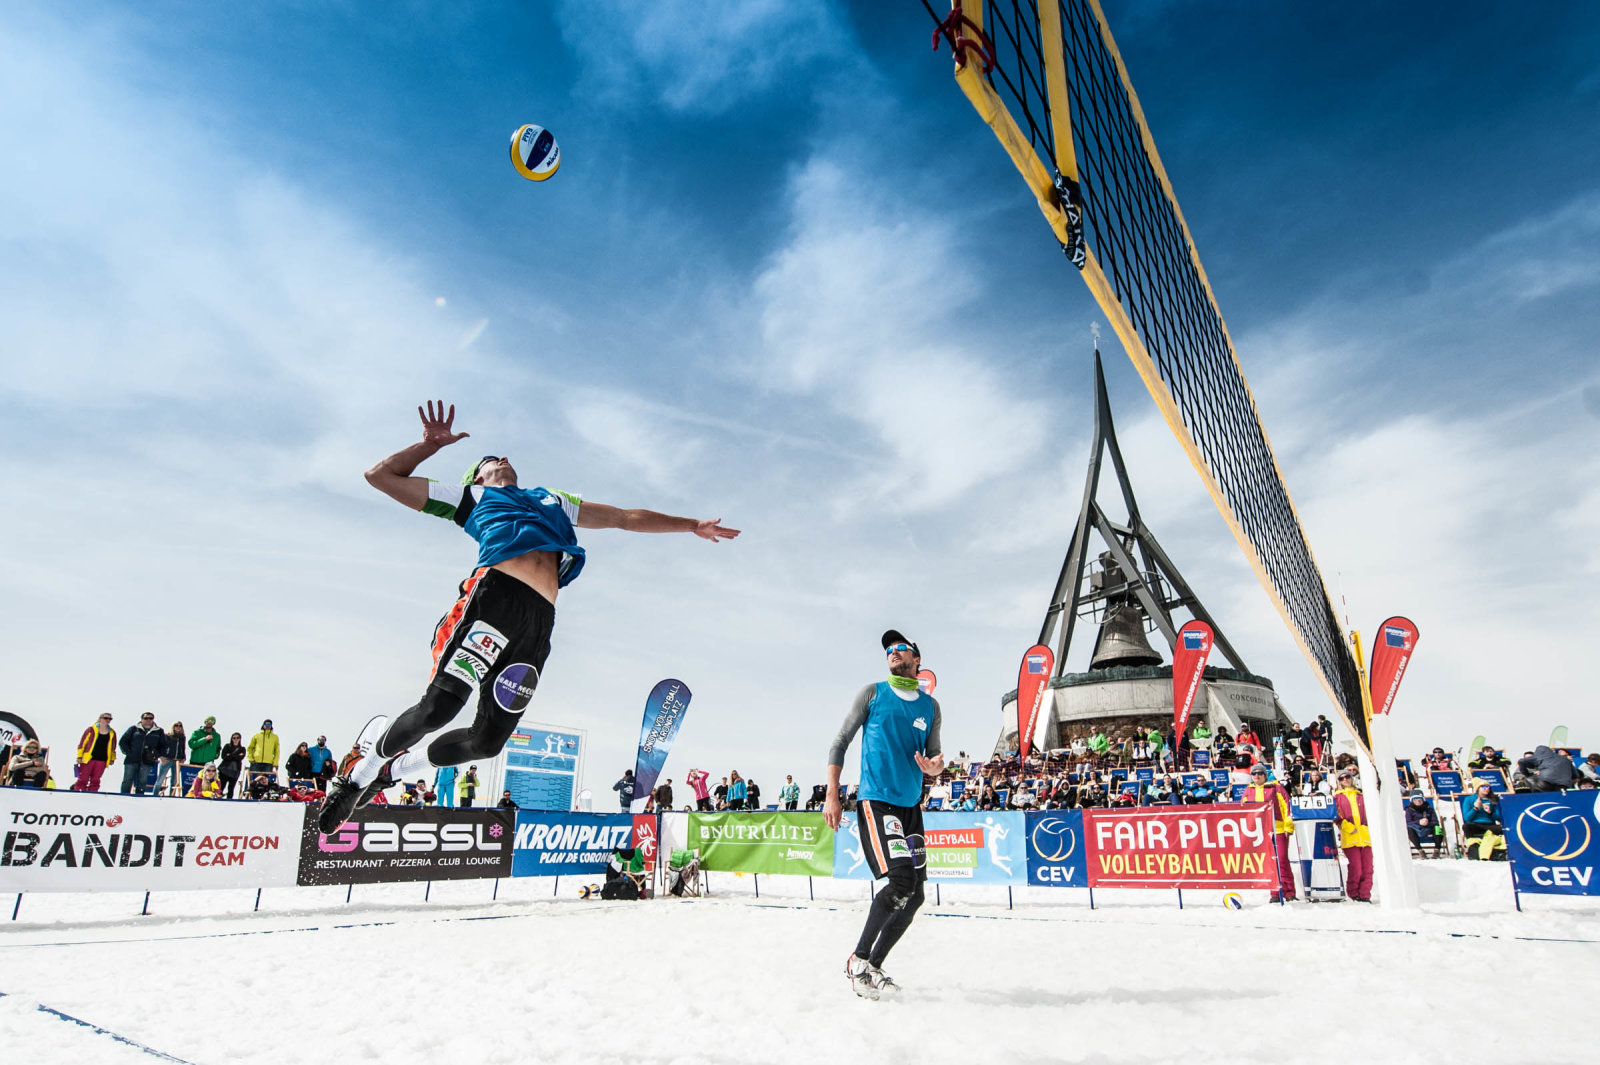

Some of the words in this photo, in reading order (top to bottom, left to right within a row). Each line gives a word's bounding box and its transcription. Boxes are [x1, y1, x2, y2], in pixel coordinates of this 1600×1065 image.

[643, 727, 659, 753] SNOW
[655, 684, 680, 727] VOLLEYBALL
[657, 699, 682, 742] KRONPLATZ
[513, 823, 632, 851] KRONPLATZ
[711, 824, 815, 841] NUTRILITE
[924, 833, 977, 846] OLLEYBALL
[1096, 820, 1169, 850] FAIR
[1178, 817, 1264, 848] PLAY
[0, 831, 196, 868] BANDIT
[197, 835, 279, 850] ACTION
[195, 851, 245, 867] CAM
[316, 859, 384, 869] RESTAURANT
[390, 858, 432, 867] PIZZERIA
[437, 857, 460, 866] CLUB
[466, 856, 501, 865] LOUNGE
[540, 852, 564, 864] PLAN
[565, 853, 578, 864] DE
[941, 852, 972, 864] TOUR
[1099, 853, 1218, 874] VOLLEYBALL
[1219, 852, 1266, 874] WAY
[1036, 866, 1075, 882] CEV
[1531, 866, 1593, 886] CEV
